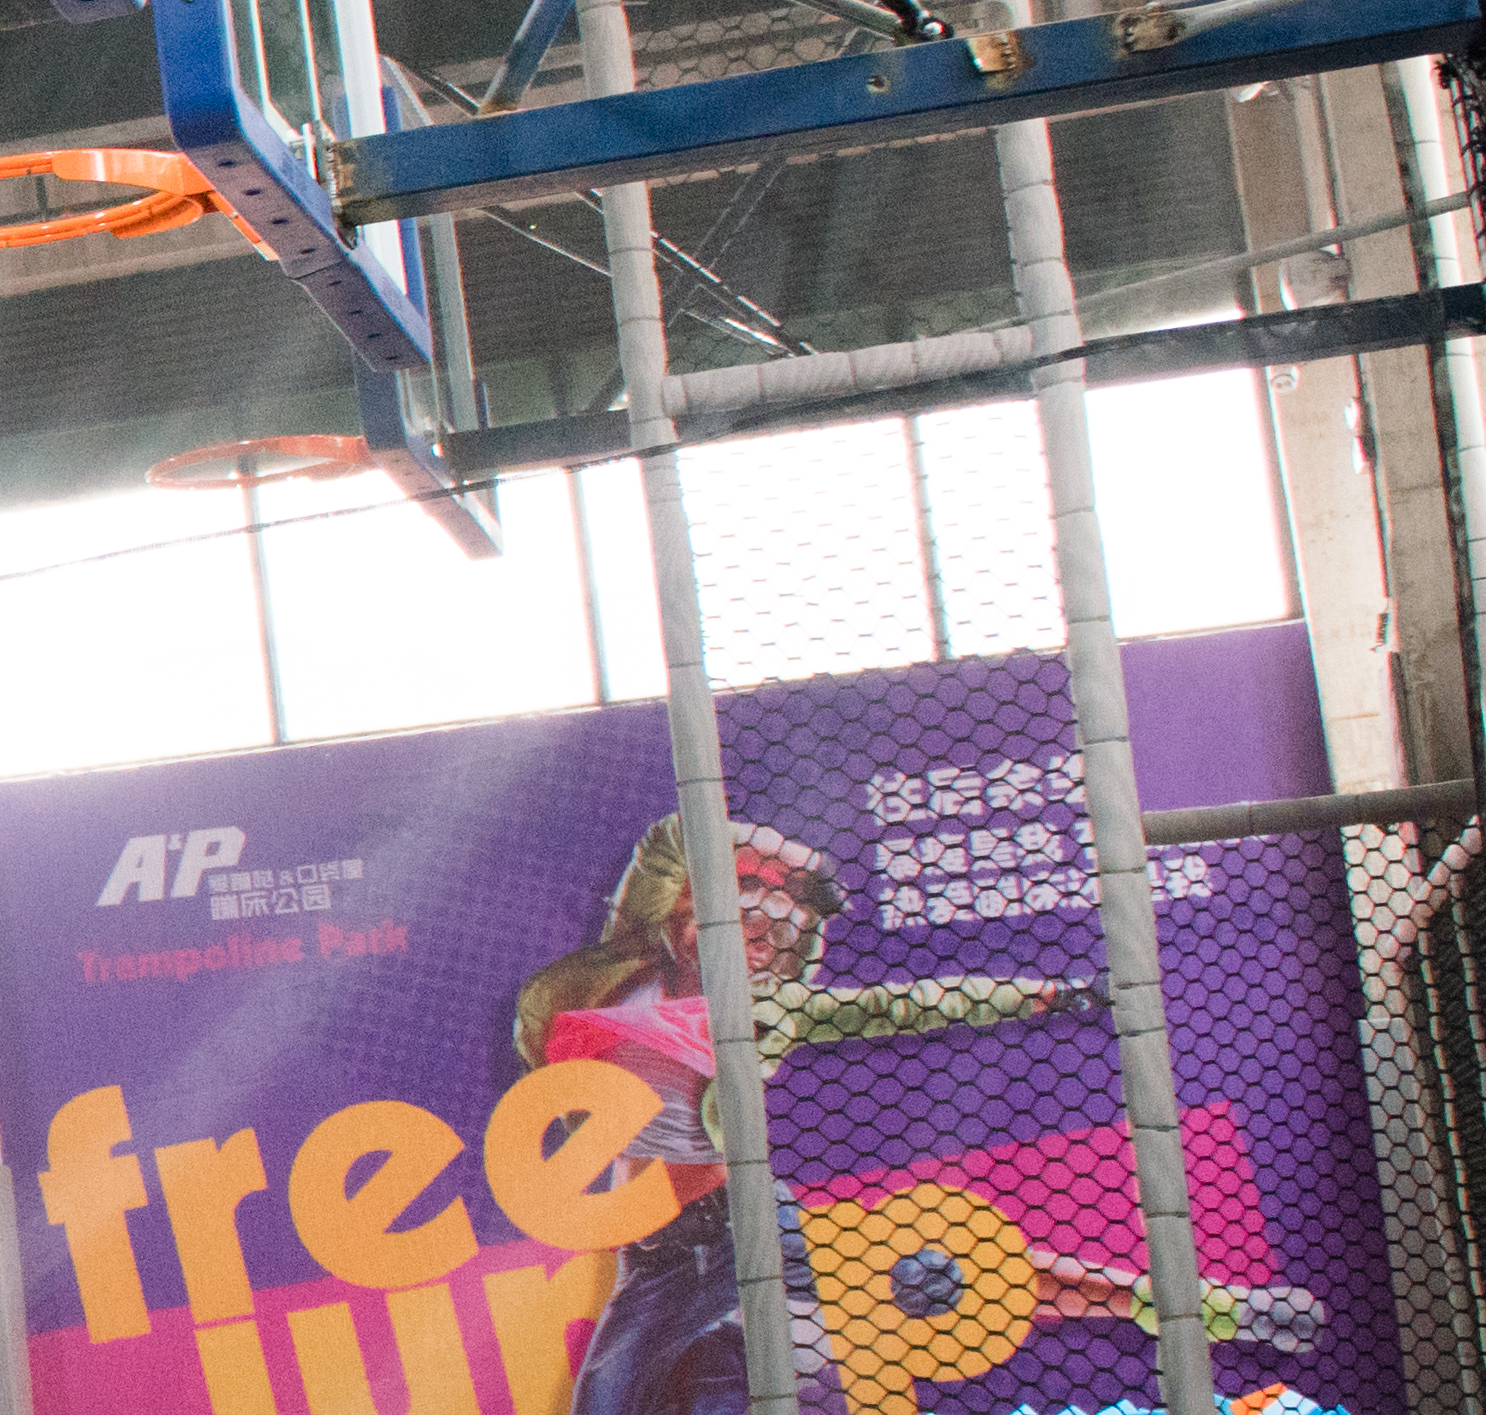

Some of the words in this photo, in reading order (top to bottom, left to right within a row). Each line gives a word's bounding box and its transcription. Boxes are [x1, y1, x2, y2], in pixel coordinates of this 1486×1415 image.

[76, 933, 305, 983] Trampoline
[318, 917, 408, 959] Park
[37, 1058, 682, 1344] free
